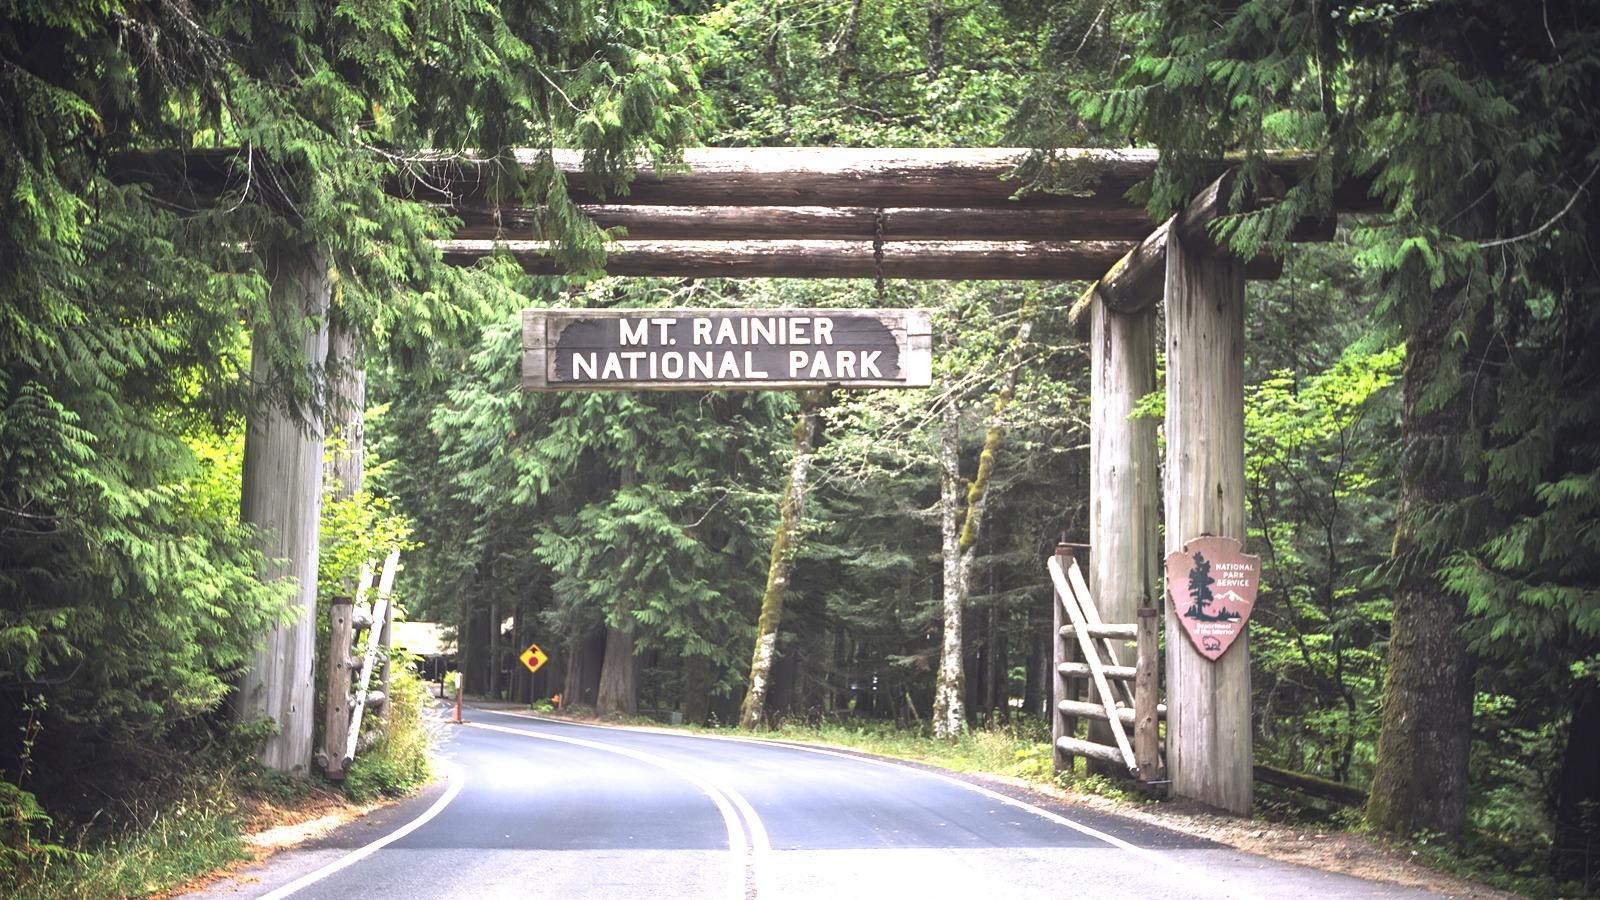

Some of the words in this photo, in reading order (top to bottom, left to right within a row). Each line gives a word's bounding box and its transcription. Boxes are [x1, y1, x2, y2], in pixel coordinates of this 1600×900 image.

[619, 318, 676, 346] MT.
[693, 317, 834, 346] RAINIER
[572, 351, 769, 379] NATIONAL
[789, 350, 883, 379] PARK
[1215, 563, 1254, 571] NATIONAL
[1223, 571, 1244, 579] PARK
[1216, 579, 1250, 587] SERVICE
